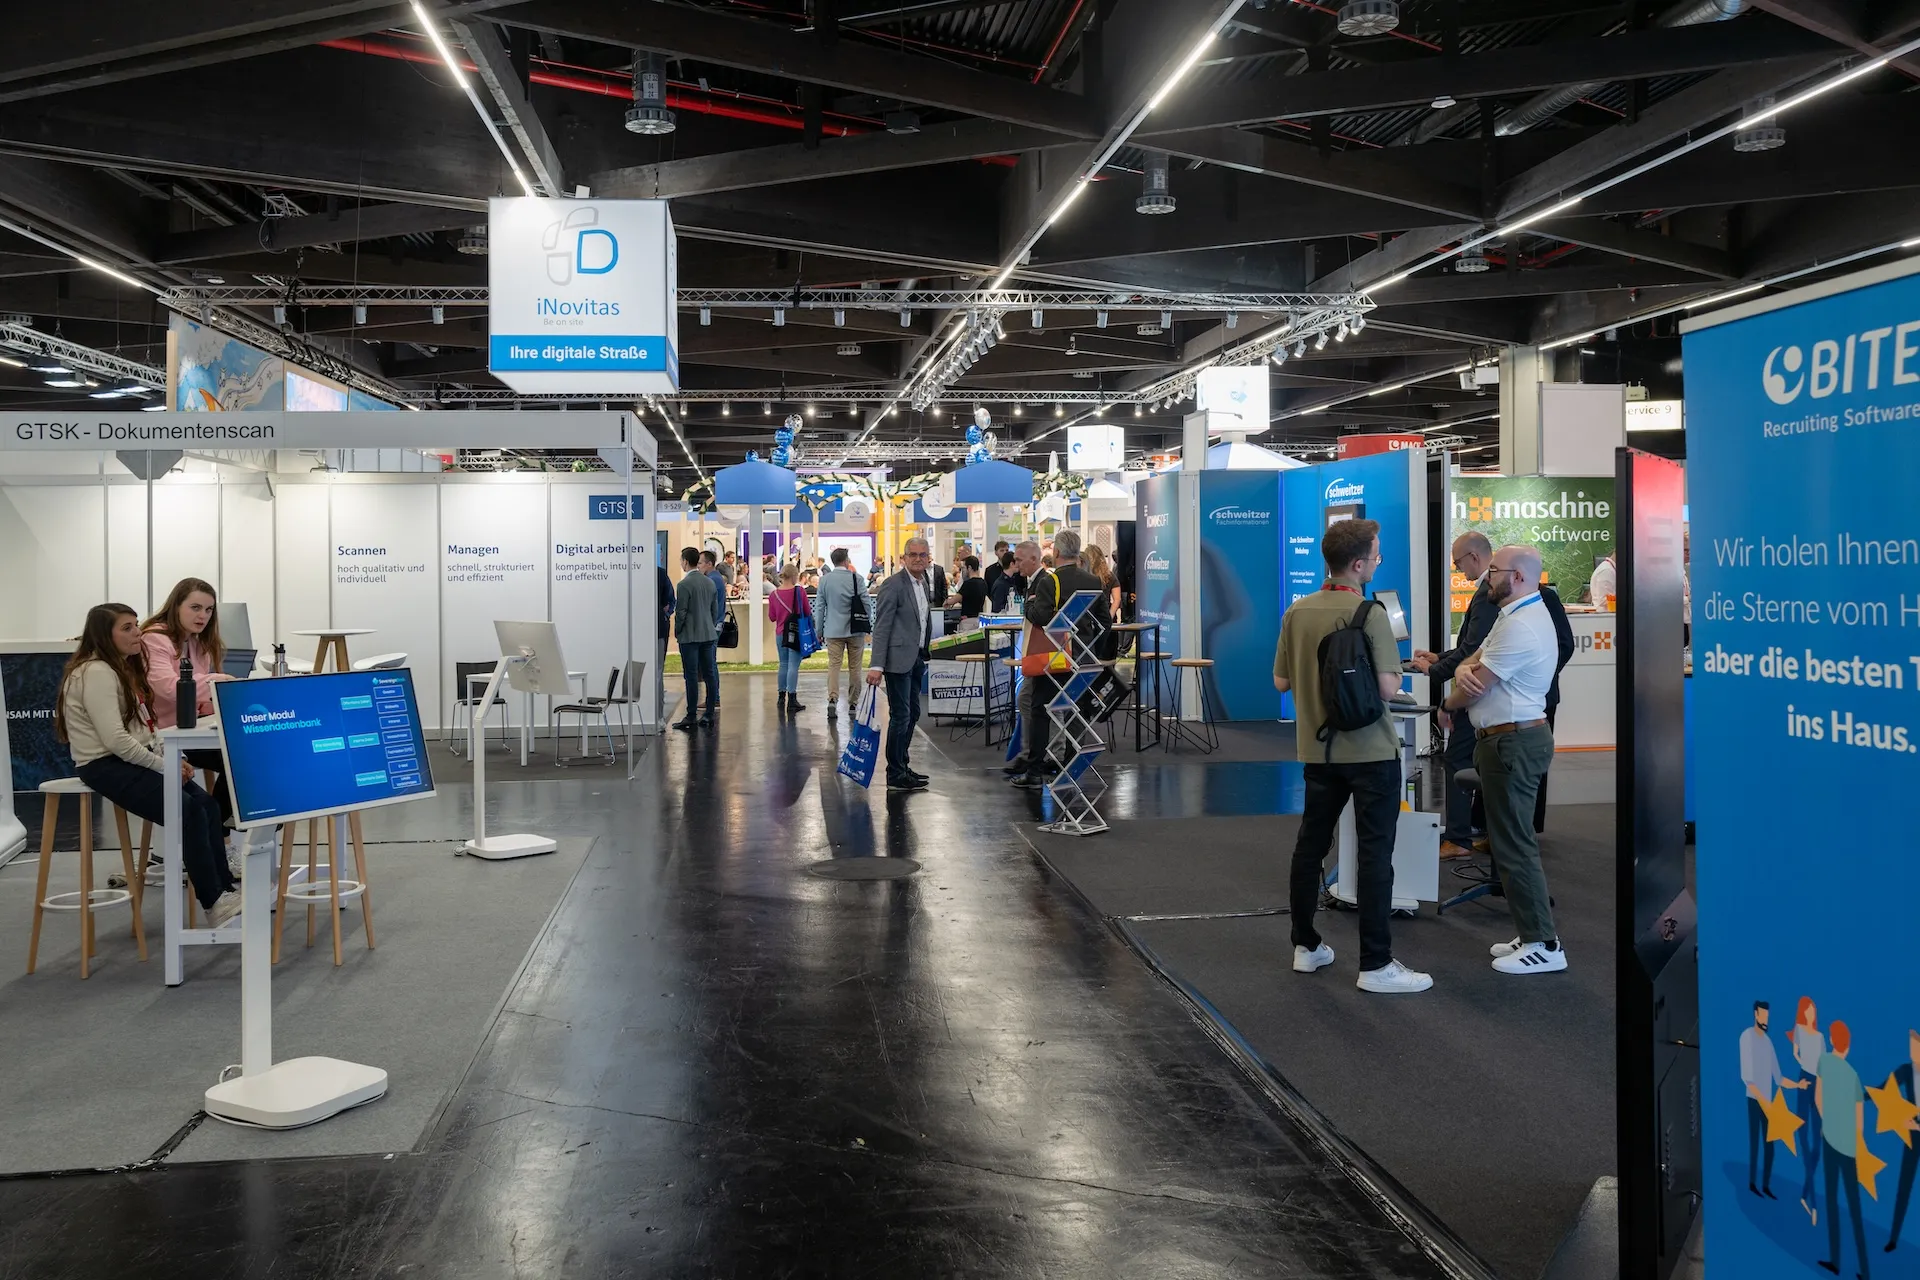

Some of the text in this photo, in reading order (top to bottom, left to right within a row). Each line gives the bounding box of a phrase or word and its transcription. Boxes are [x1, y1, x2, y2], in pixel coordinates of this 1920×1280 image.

[536, 298, 620, 316] iNovitas
[543, 318, 554, 326] Be
[569, 318, 584, 326] site
[510, 345, 648, 362] Ihre digitale Straße
[1809, 320, 1920, 399] BITE
[1626, 405, 1672, 415] ervice 9
[1763, 403, 1920, 438] Recruiting Software
[16, 423, 80, 440] GTSK
[98, 422, 275, 440] Dokumentenscan
[1329, 483, 1364, 498] schweitzer
[1216, 510, 1271, 519] schweitzer
[1530, 525, 1610, 542] Software
[338, 546, 387, 556] Scannen
[448, 545, 499, 557] Managen
[556, 544, 594, 557] Digital
[1713, 532, 1919, 567] Wir holen Ihnen
[337, 564, 425, 574] hoch qualitativ und
[447, 563, 535, 573] schnell, strukturiert
[555, 562, 608, 573] kompatibel,
[337, 574, 387, 583] individuell
[447, 573, 504, 582] und effizient
[555, 572, 609, 581] und effektiv
[1704, 591, 1735, 621] die
[1742, 591, 1820, 624] Sterne
[1827, 600, 1888, 627] vom
[1704, 643, 1754, 676] aber
[1759, 646, 1799, 680] die
[1805, 648, 1903, 690] besten
[32, 710, 50, 719] MIT
[240, 709, 296, 724] Unser Modul
[242, 717, 322, 735] Wissendatenbank
[1787, 704, 1917, 754] ins Haus.
